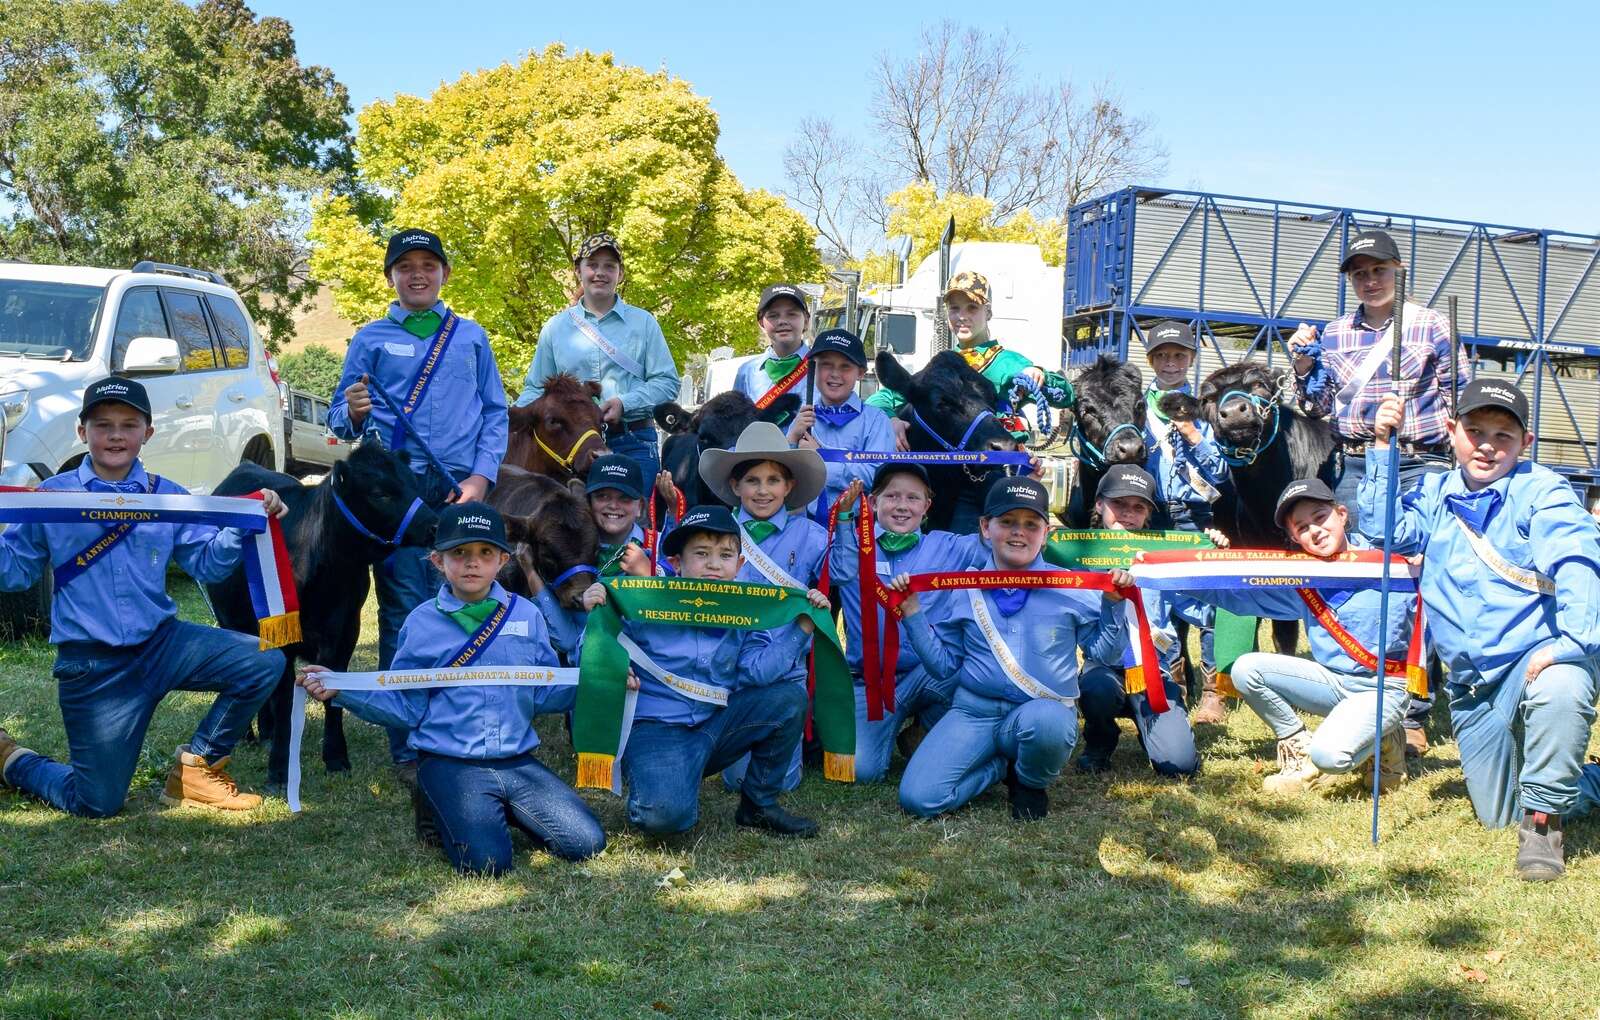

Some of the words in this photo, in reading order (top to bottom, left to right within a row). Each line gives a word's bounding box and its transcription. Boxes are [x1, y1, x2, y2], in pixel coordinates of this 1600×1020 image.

[402, 235, 430, 244] Nutrien
[826, 335, 852, 346] Nutrien
[775, 362, 809, 393] TALLANGATT
[96, 384, 129, 394] Nutrien
[409, 376, 428, 406] ANNUAL
[600, 465, 628, 474] Nutrien
[1006, 486, 1038, 496] Nutrien
[88, 511, 151, 520] CHAMPION
[457, 515, 492, 526] Nutrien
[1061, 532, 1097, 541] ANNUAL
[1165, 533, 1193, 543] SHOW
[84, 532, 120, 560] ANNUAL
[1204, 551, 1244, 560] ANNUAL
[1081, 557, 1121, 566] RESERVE
[940, 577, 977, 586] ANNUAL
[979, 575, 1043, 585] TALLANGATTA
[1046, 576, 1074, 585] SHOW
[1249, 577, 1303, 586] CHAMPION
[621, 579, 665, 589] ANNUAL
[668, 580, 743, 595] TALLANGATTA
[746, 586, 778, 598] SHOW
[645, 609, 691, 622] RESERVE
[694, 612, 752, 625] CHAMPION
[975, 607, 994, 641] ANNUAL
[1303, 587, 1324, 616] NNUAL
[1321, 612, 1369, 661] TALLANGATTA
[451, 646, 477, 669] NUAL
[473, 605, 508, 648] TALLANGA
[388, 674, 432, 684] ANNUAL
[435, 671, 511, 682] TALLANGATTA
[514, 671, 544, 680] SHOW
